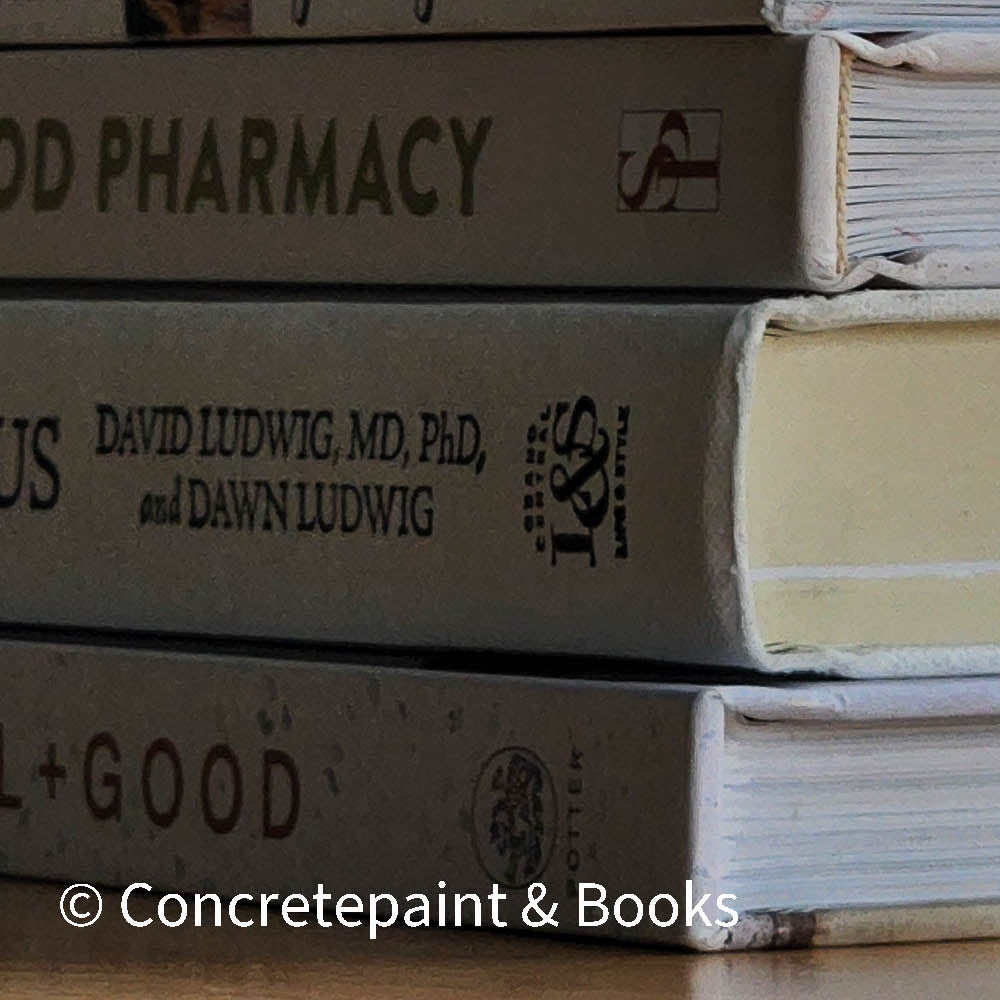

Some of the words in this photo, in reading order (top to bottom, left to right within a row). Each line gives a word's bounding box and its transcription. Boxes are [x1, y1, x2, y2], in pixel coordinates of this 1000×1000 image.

[98, 114, 493, 217] PHARMACY
[96, 403, 193, 456] DAVID
[200, 404, 343, 466] LUDWIG,
[347, 409, 411, 468] MD,
[419, 411, 487, 475] PhD,
[140, 475, 182, 526] and
[188, 477, 290, 531] DAWN
[298, 481, 434, 537] LUDWIG
